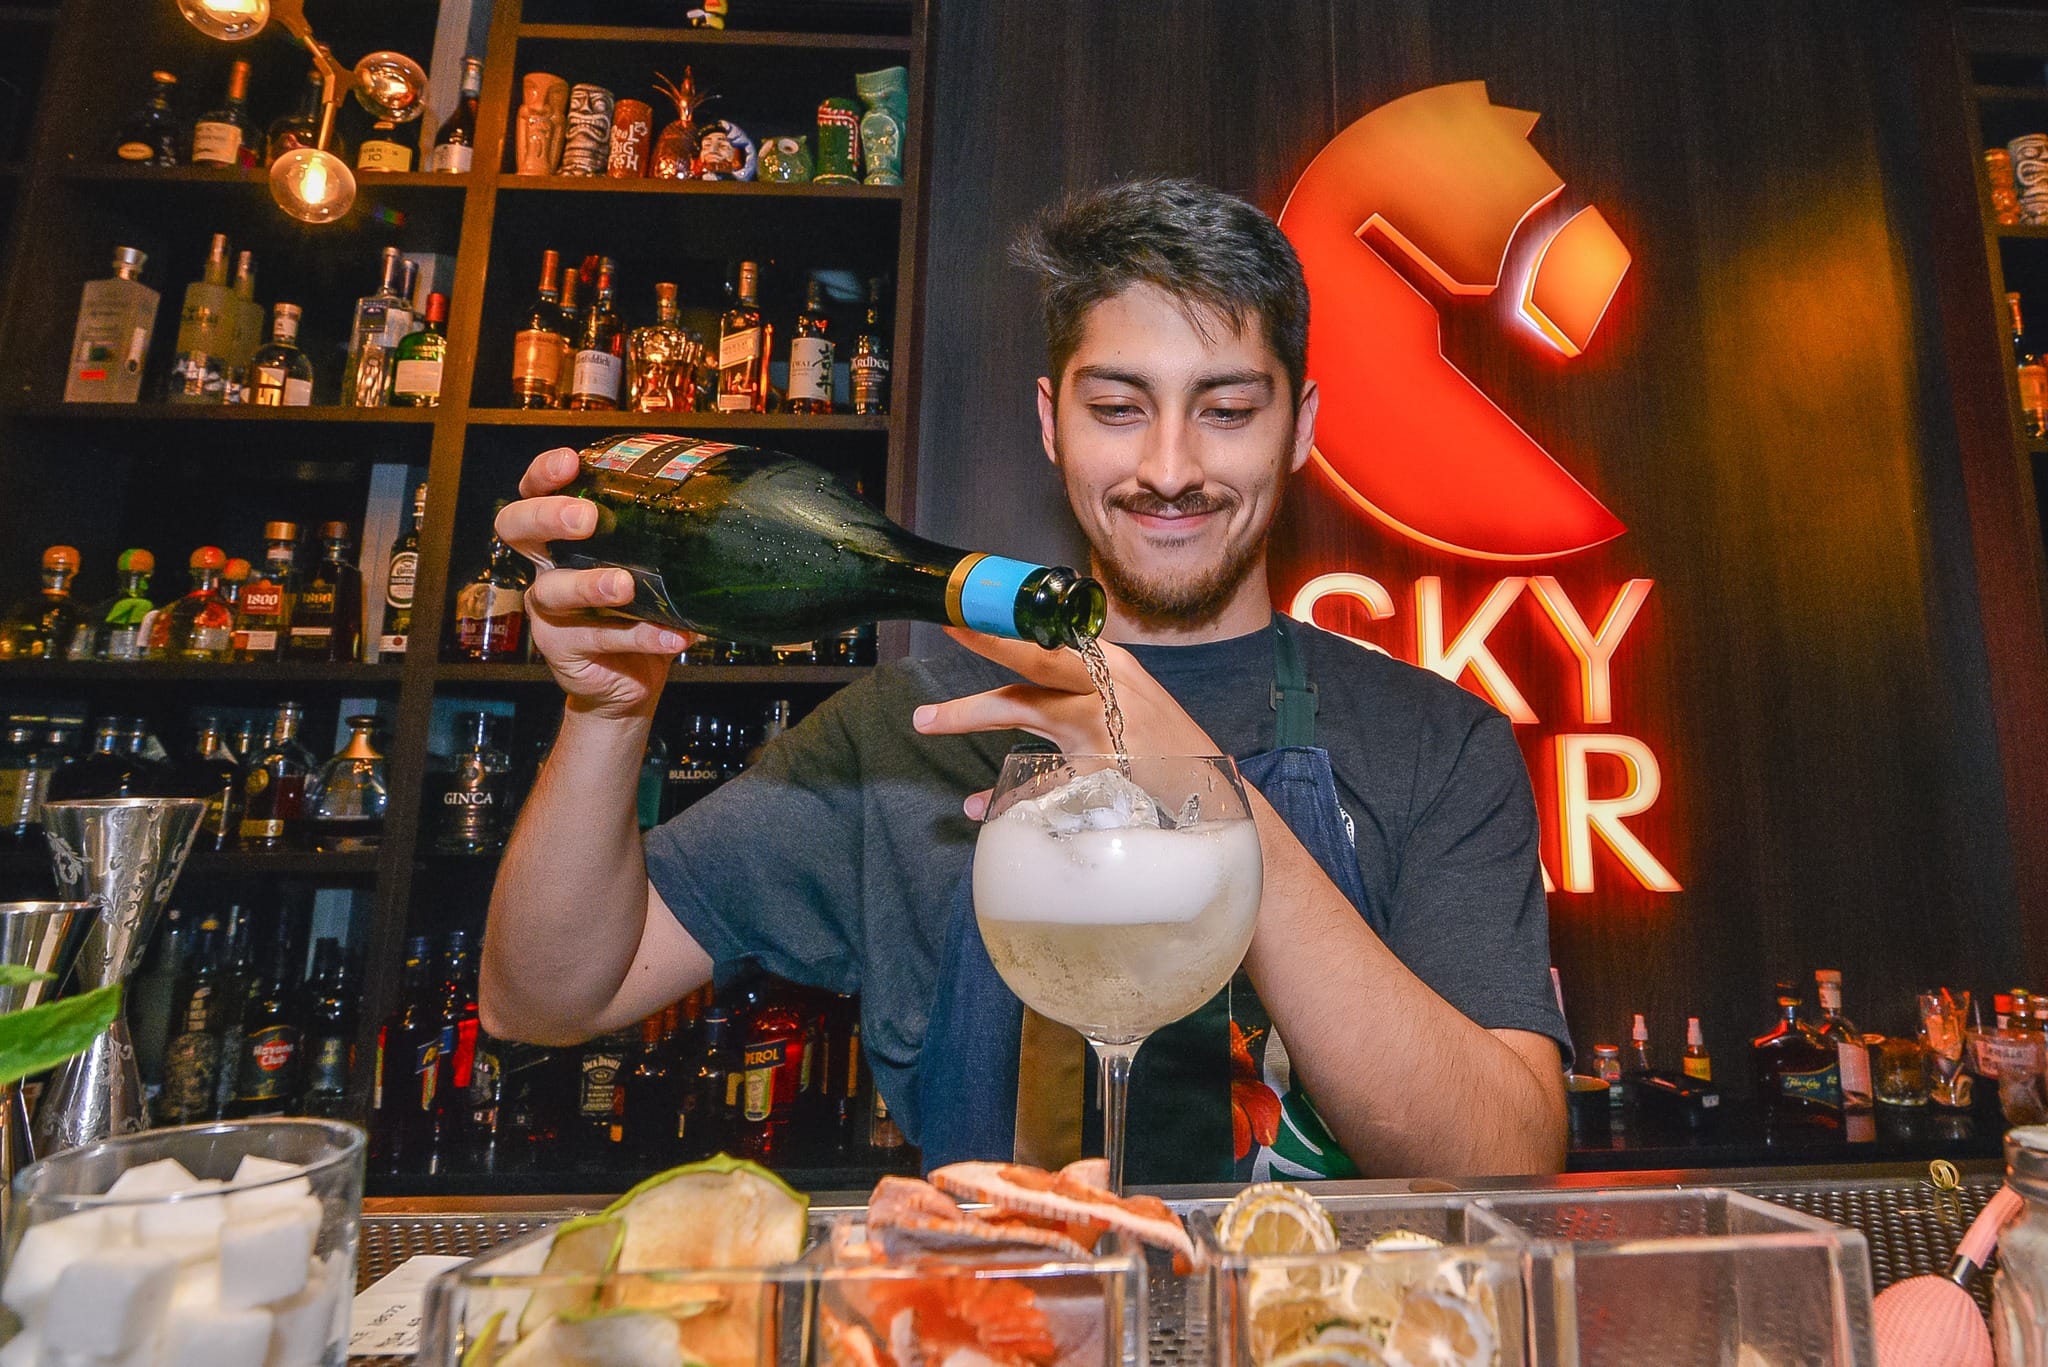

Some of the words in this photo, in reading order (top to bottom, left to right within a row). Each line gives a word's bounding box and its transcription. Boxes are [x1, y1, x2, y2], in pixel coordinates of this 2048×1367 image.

[247, 594, 279, 605] 1800
[1291, 573, 1654, 724] SKY
[668, 769, 718, 780] BULLDOG
